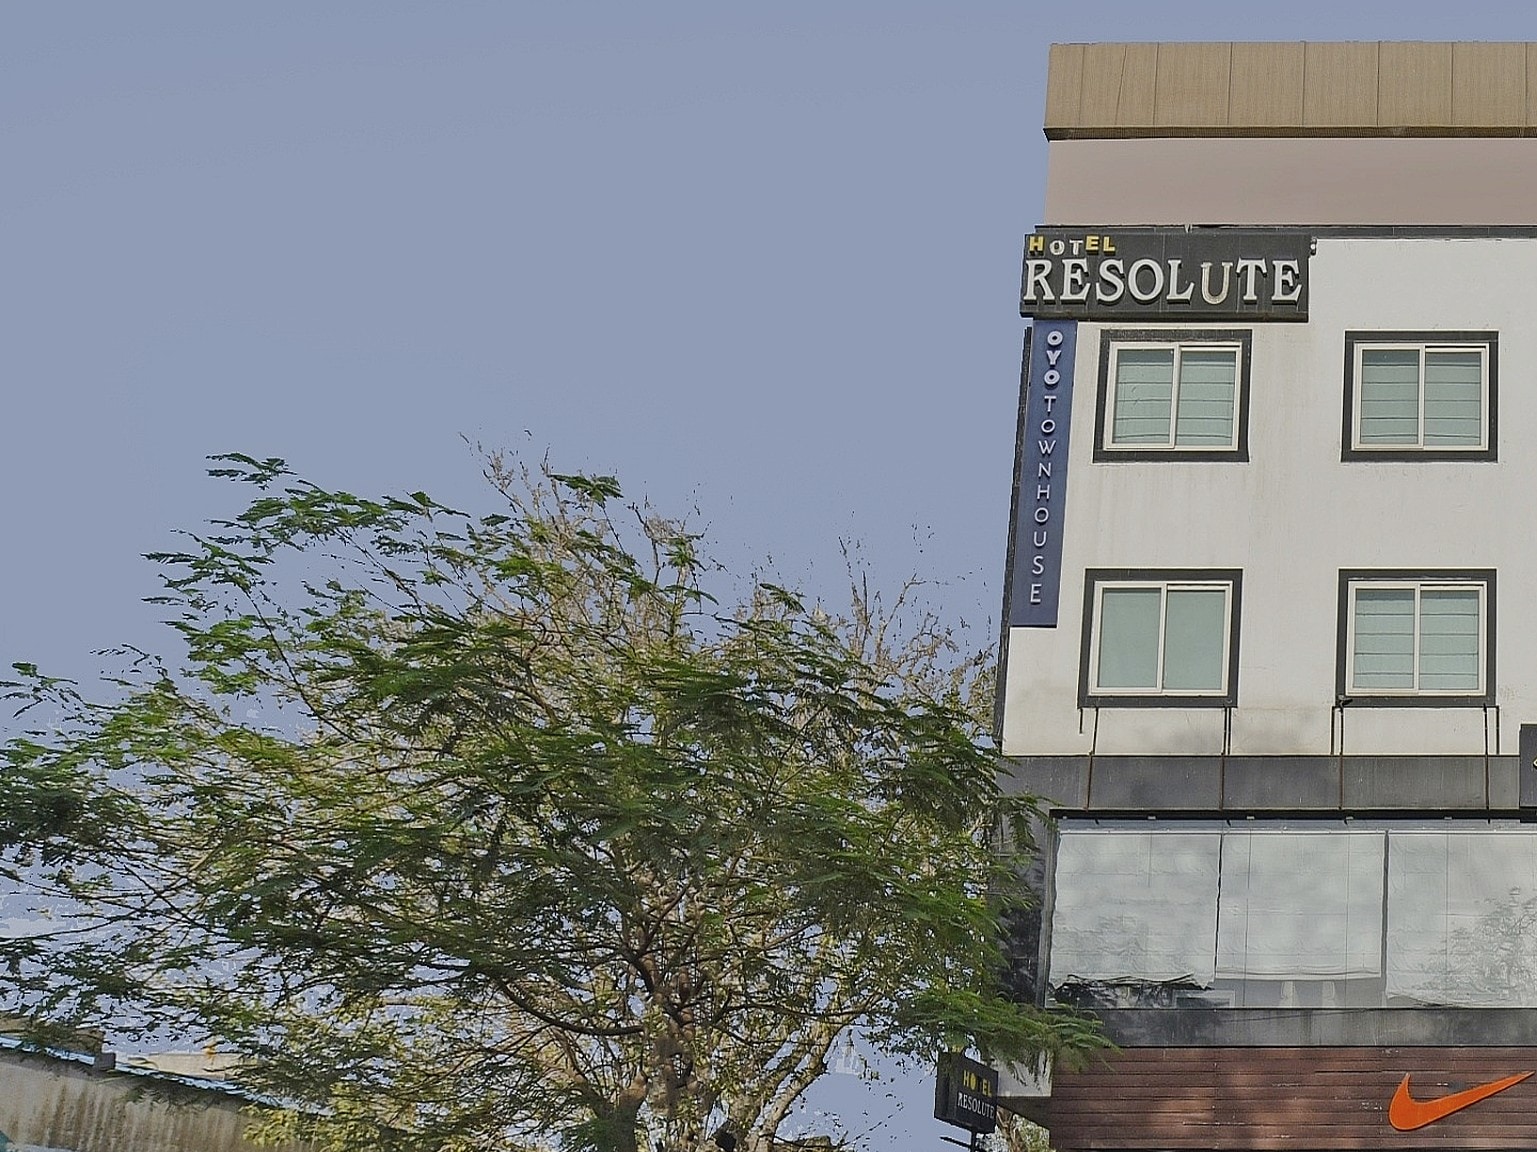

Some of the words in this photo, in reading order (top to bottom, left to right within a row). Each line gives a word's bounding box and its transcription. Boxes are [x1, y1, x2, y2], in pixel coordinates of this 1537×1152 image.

[1028, 235, 1117, 256] HOTEL
[1023, 257, 1303, 306] RESOLUTE
[1043, 330, 1064, 388] OYO
[1029, 395, 1058, 604] TOWNHOUSE
[963, 1070, 992, 1096] HOEL
[958, 1092, 995, 1119] RESOLUTE
